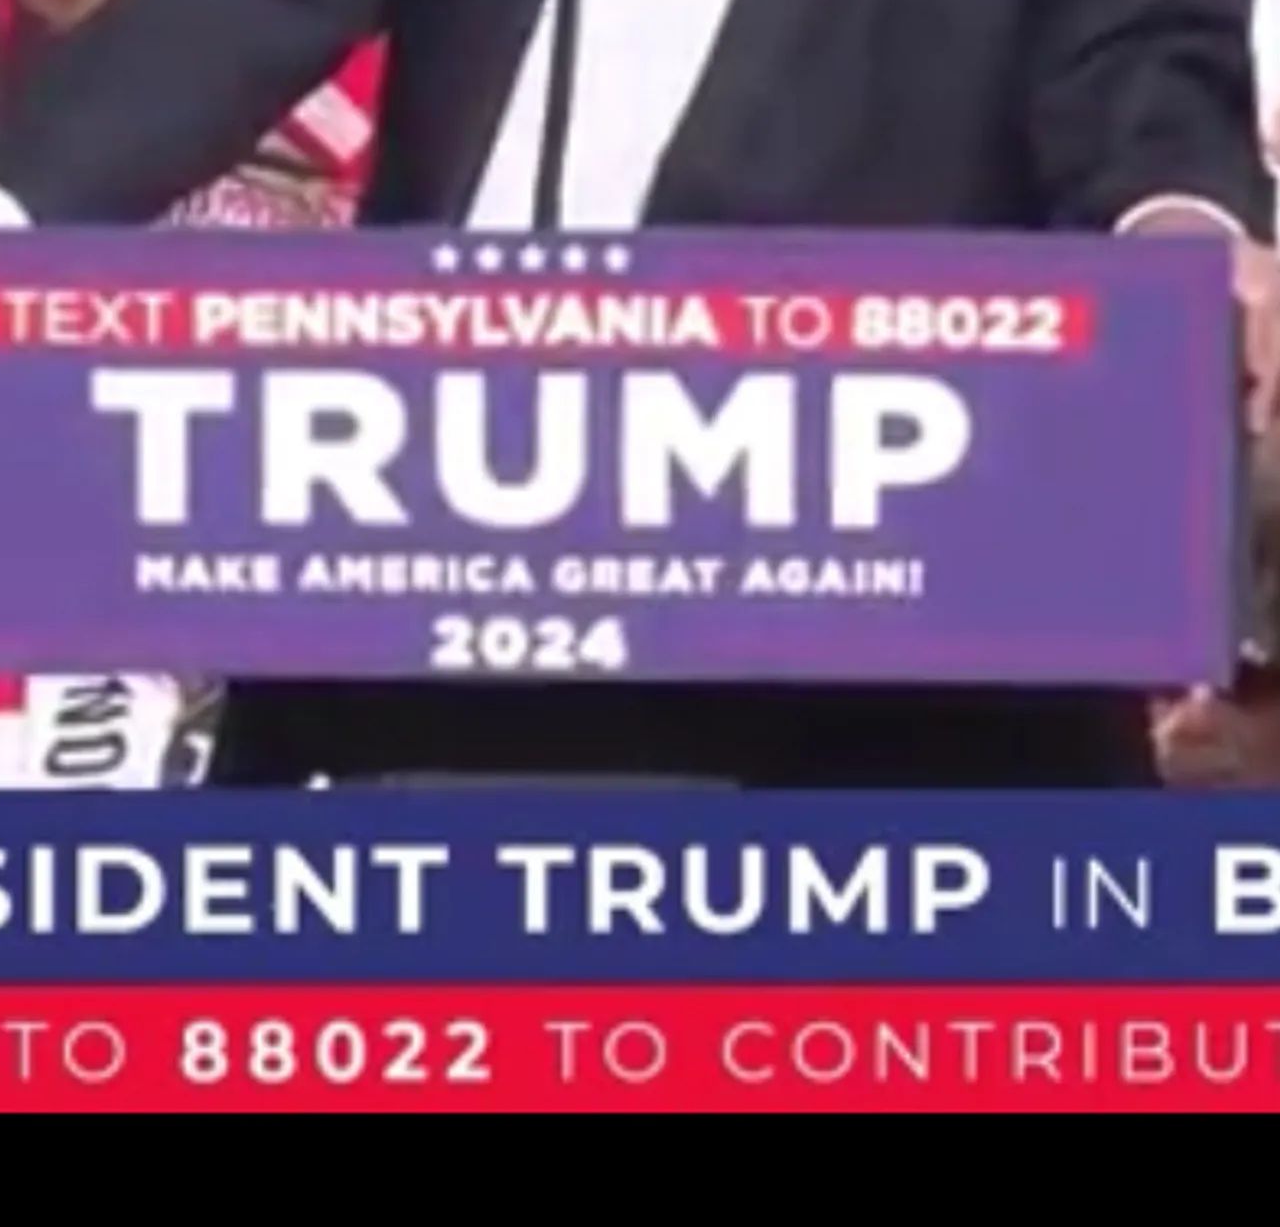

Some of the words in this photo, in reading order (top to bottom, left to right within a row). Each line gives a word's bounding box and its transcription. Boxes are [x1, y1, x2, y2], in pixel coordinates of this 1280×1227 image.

[1, 289, 181, 346] TEXT
[192, 291, 719, 348] PENNSYLVANIA
[741, 296, 831, 349] TO
[850, 296, 1063, 351] 88022
[90, 369, 973, 530] TRUMP
[135, 554, 281, 594] MAKE
[297, 554, 535, 595] AMERICA
[551, 557, 724, 596] GREAT
[739, 558, 924, 598] AGAIN!
[430, 616, 629, 670] 2024
